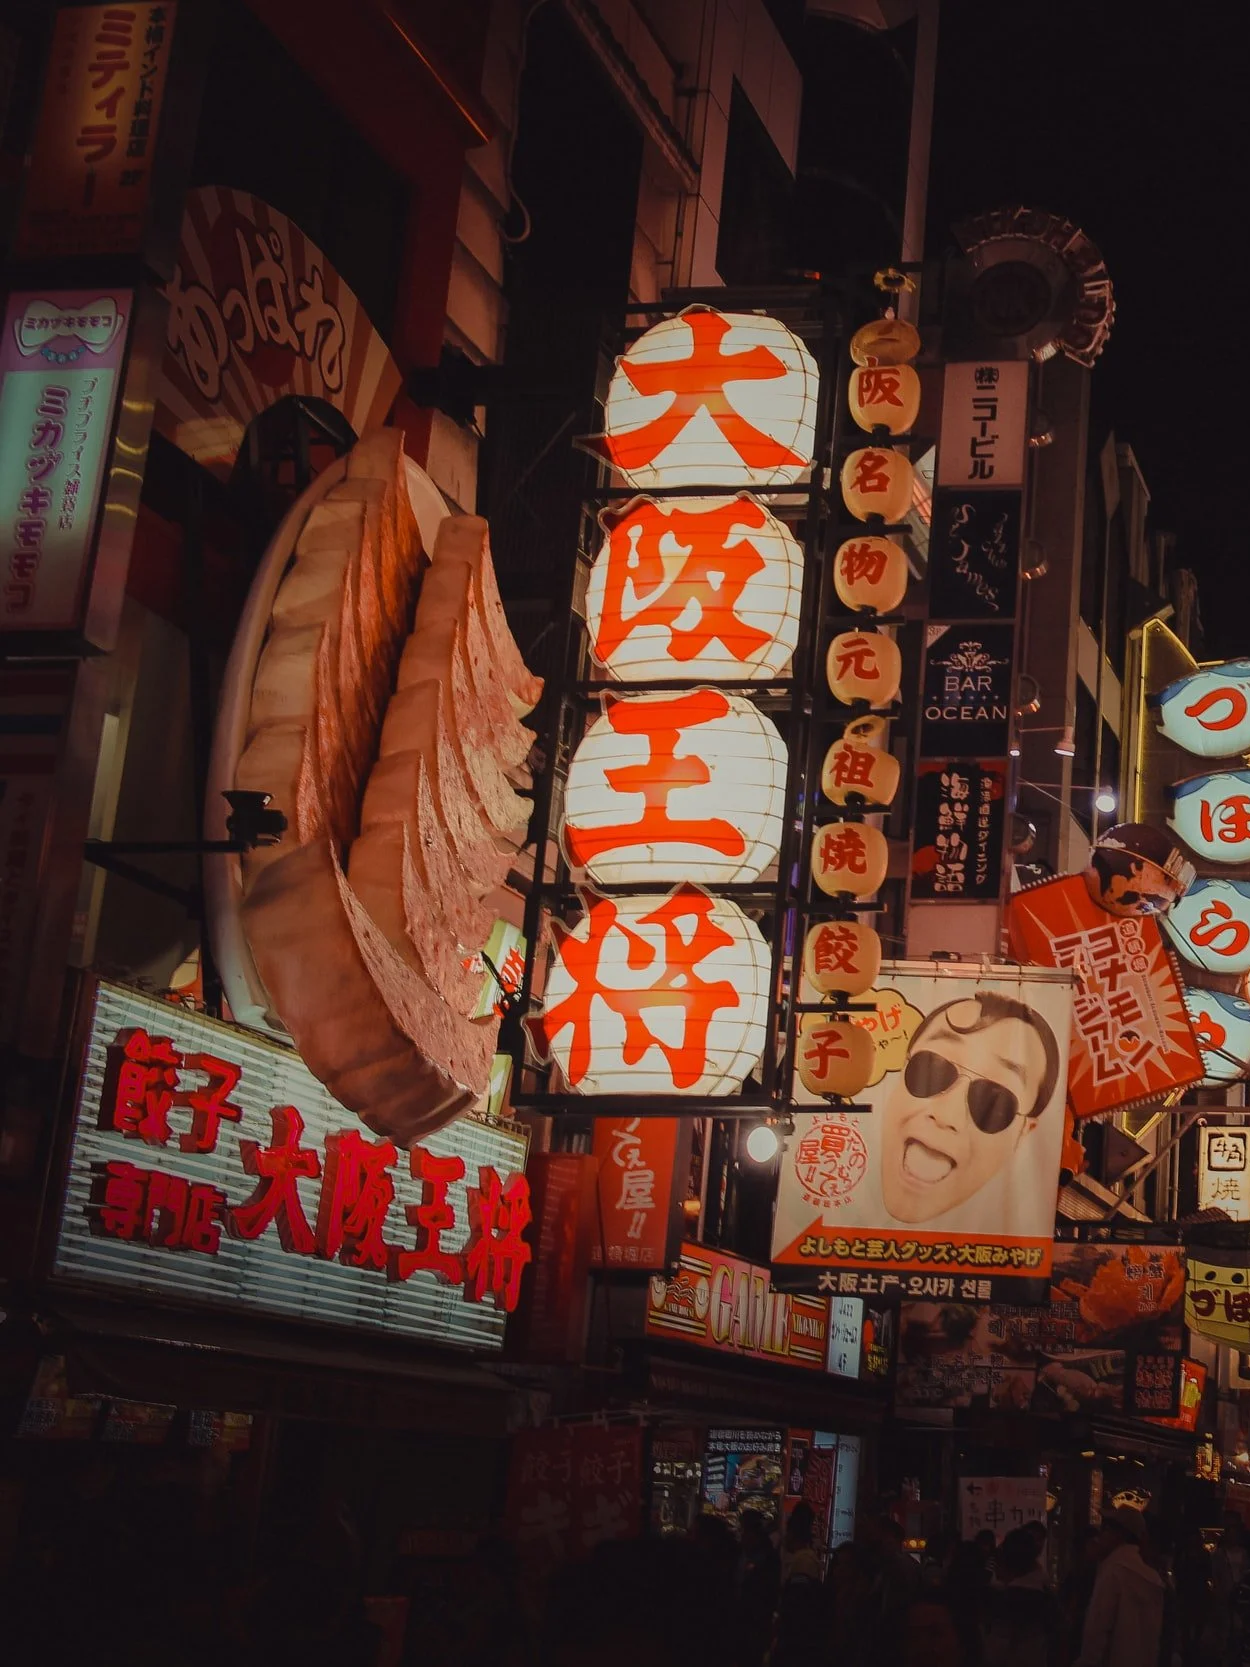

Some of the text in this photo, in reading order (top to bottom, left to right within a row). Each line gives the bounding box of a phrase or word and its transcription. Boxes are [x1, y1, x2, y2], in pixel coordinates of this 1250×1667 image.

[76, 9, 136, 208] ミティラー
[6, 385, 69, 613] ミカヅキモモコ
[527, 310, 810, 1090] 大阪王将
[925, 705, 1008, 721] OCEAN
[944, 675, 993, 693] BAR
[108, 1026, 243, 1153] 餃子
[228, 1106, 534, 1313] 大阪王将
[580, 1450, 633, 1487] 餃子
